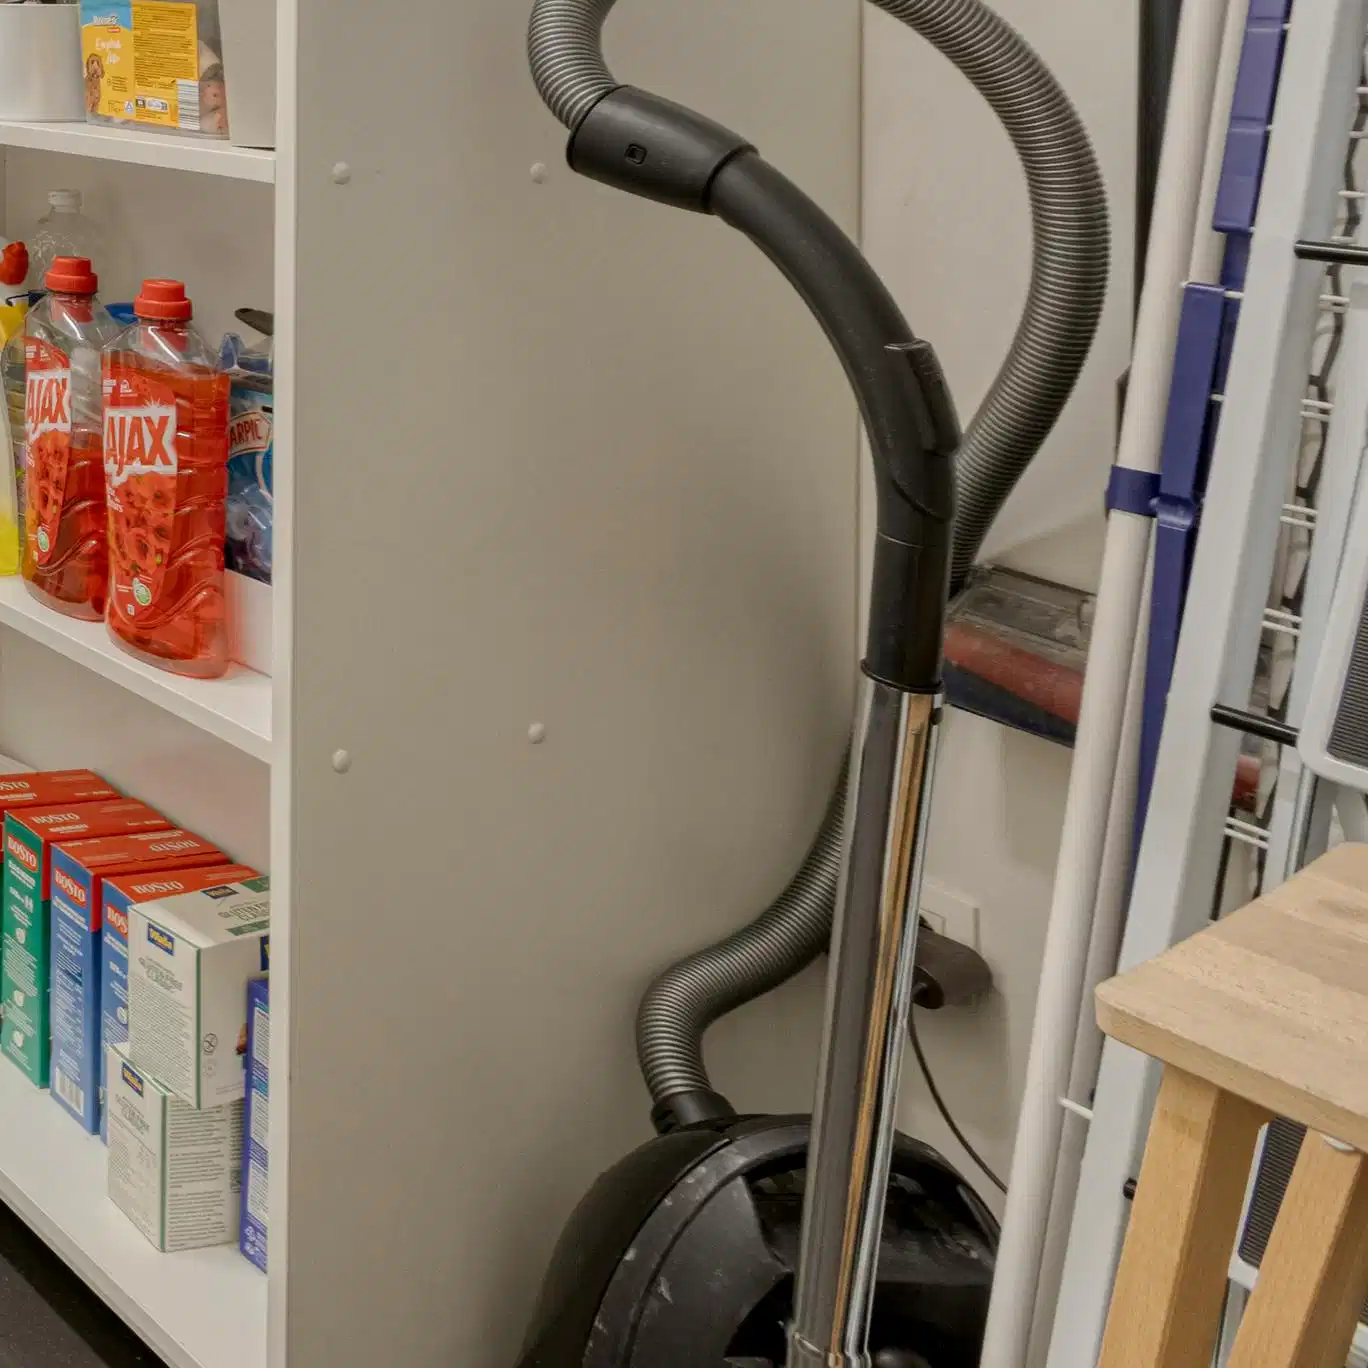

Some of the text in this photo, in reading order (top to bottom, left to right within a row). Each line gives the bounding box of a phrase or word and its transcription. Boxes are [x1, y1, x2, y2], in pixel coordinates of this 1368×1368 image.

[26, 377, 69, 433] AJAX
[105, 415, 173, 477] AJAX
[31, 812, 81, 825] BOSTO
[8, 835, 37, 868] BOSTO
[56, 869, 86, 903] BOSTO
[131, 879, 184, 895] BOSTO
